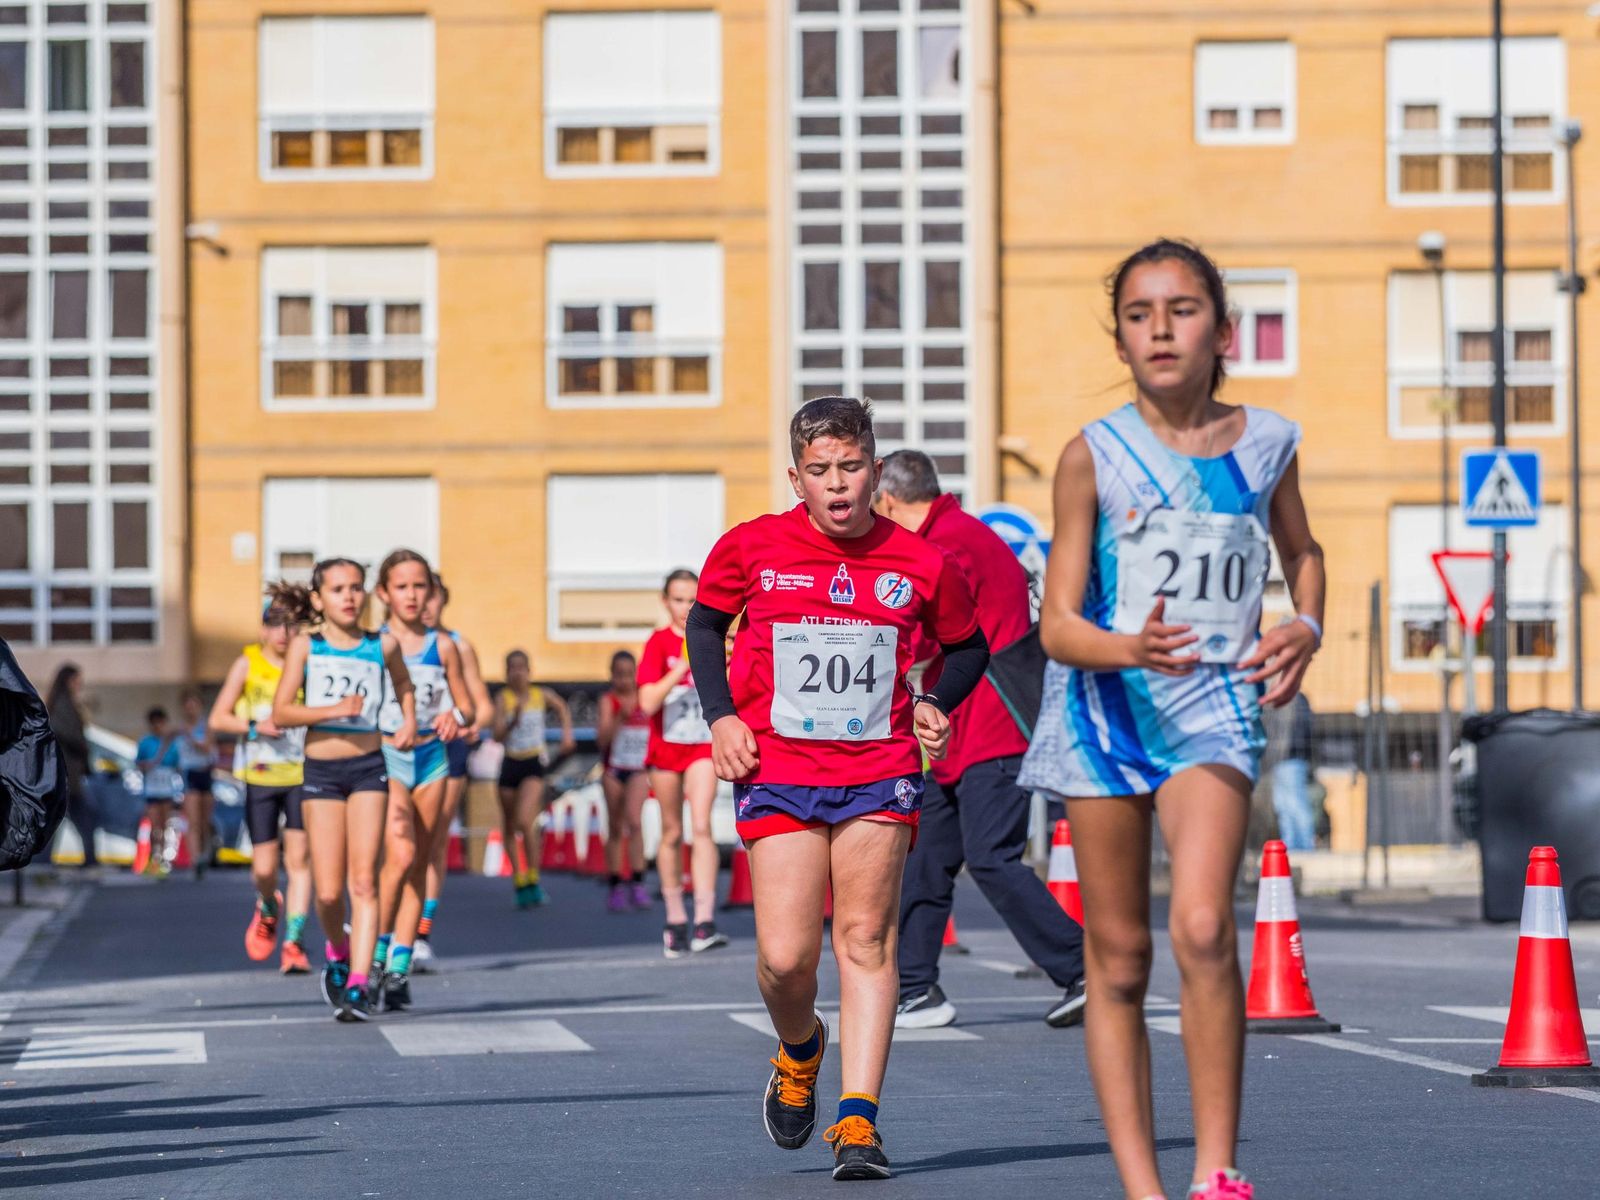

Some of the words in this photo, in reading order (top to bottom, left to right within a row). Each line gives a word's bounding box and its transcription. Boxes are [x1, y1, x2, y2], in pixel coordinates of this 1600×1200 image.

[776, 573, 815, 582] Ayuntamiento
[1153, 549, 1246, 603] 210
[323, 675, 368, 698] 226
[798, 653, 877, 694] 204
